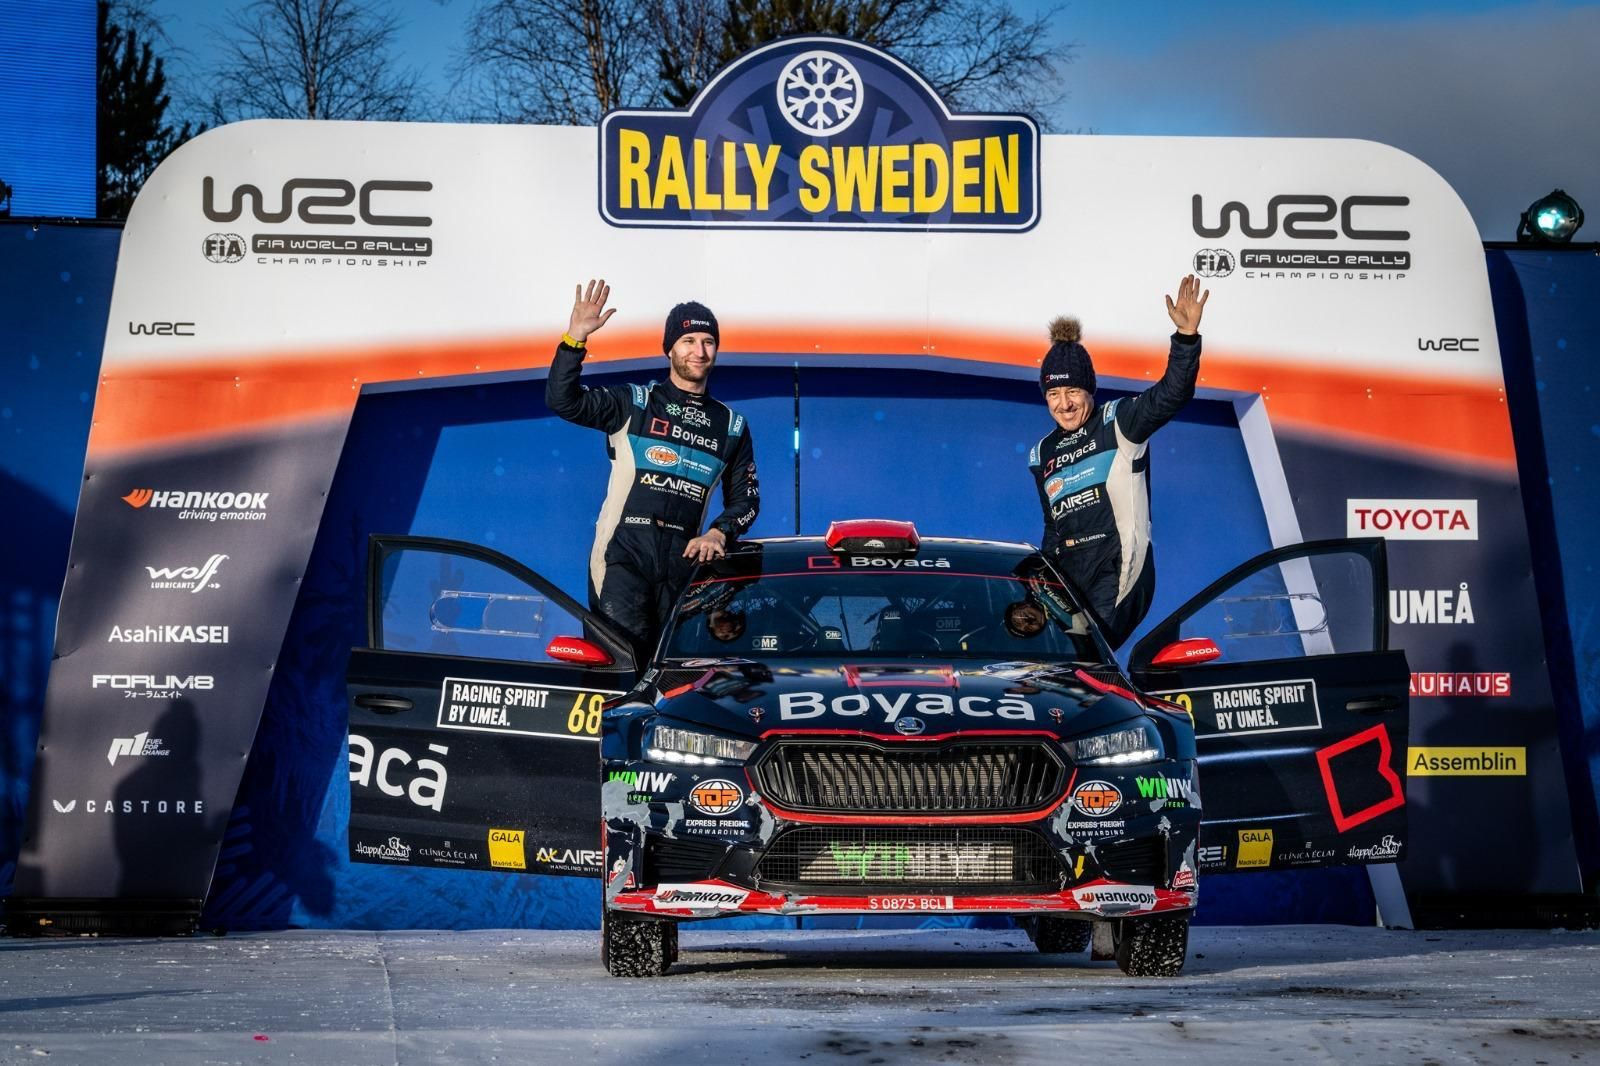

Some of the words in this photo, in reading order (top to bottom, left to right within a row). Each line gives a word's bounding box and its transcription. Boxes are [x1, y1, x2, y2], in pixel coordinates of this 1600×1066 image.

[619, 128, 782, 211] RALLY
[799, 133, 1020, 214] SWEDEN
[203, 175, 433, 227] WRC
[1192, 194, 1410, 240] WRC
[257, 239, 285, 249] FIA
[290, 240, 357, 250] WORLD
[362, 241, 428, 252] RALLY
[257, 257, 427, 267] CHAMPIONSHIP
[1245, 254, 1271, 264] FIA
[1276, 255, 1340, 265] WORLD
[1345, 255, 1407, 266] RALLY
[1245, 271, 1406, 280] CHAMPIONSHIP
[129, 321, 195, 337] WRC
[1418, 337, 1480, 352] WRC
[178, 509, 217, 522] driving
[219, 510, 267, 521] emotion
[1355, 508, 1470, 531] TOYOTA
[1389, 582, 1475, 624] UMEÅ
[752, 637, 778, 649] OMP
[92, 674, 215, 690] FORUM8
[1409, 676, 1508, 693] AUHAUS
[124, 690, 182, 698] フォーラムエイト
[452, 683, 502, 704] RACING
[504, 688, 549, 708] SPIRIT
[1213, 688, 1262, 710] RACING
[1263, 685, 1306, 705] SPIRIT
[448, 704, 468, 723] BY
[469, 705, 511, 727] UMEÅ.
[567, 692, 605, 735] 68
[1216, 712, 1233, 730] BY
[1236, 705, 1279, 728] UMEÅ.
[1414, 752, 1516, 770] Assemblin
[692, 789, 738, 806] TOP
[1076, 790, 1118, 808] TOP
[86, 800, 203, 814] CASTORE
[719, 820, 750, 828] FREIGHT
[1067, 821, 1098, 829] EXPRESS
[1100, 820, 1125, 828] FREIGHT
[491, 832, 521, 843] GALA
[1242, 833, 1271, 843] GALA
[870, 898, 878, 910] S
[882, 898, 916, 910] 0875
[920, 898, 945, 910] BCL
